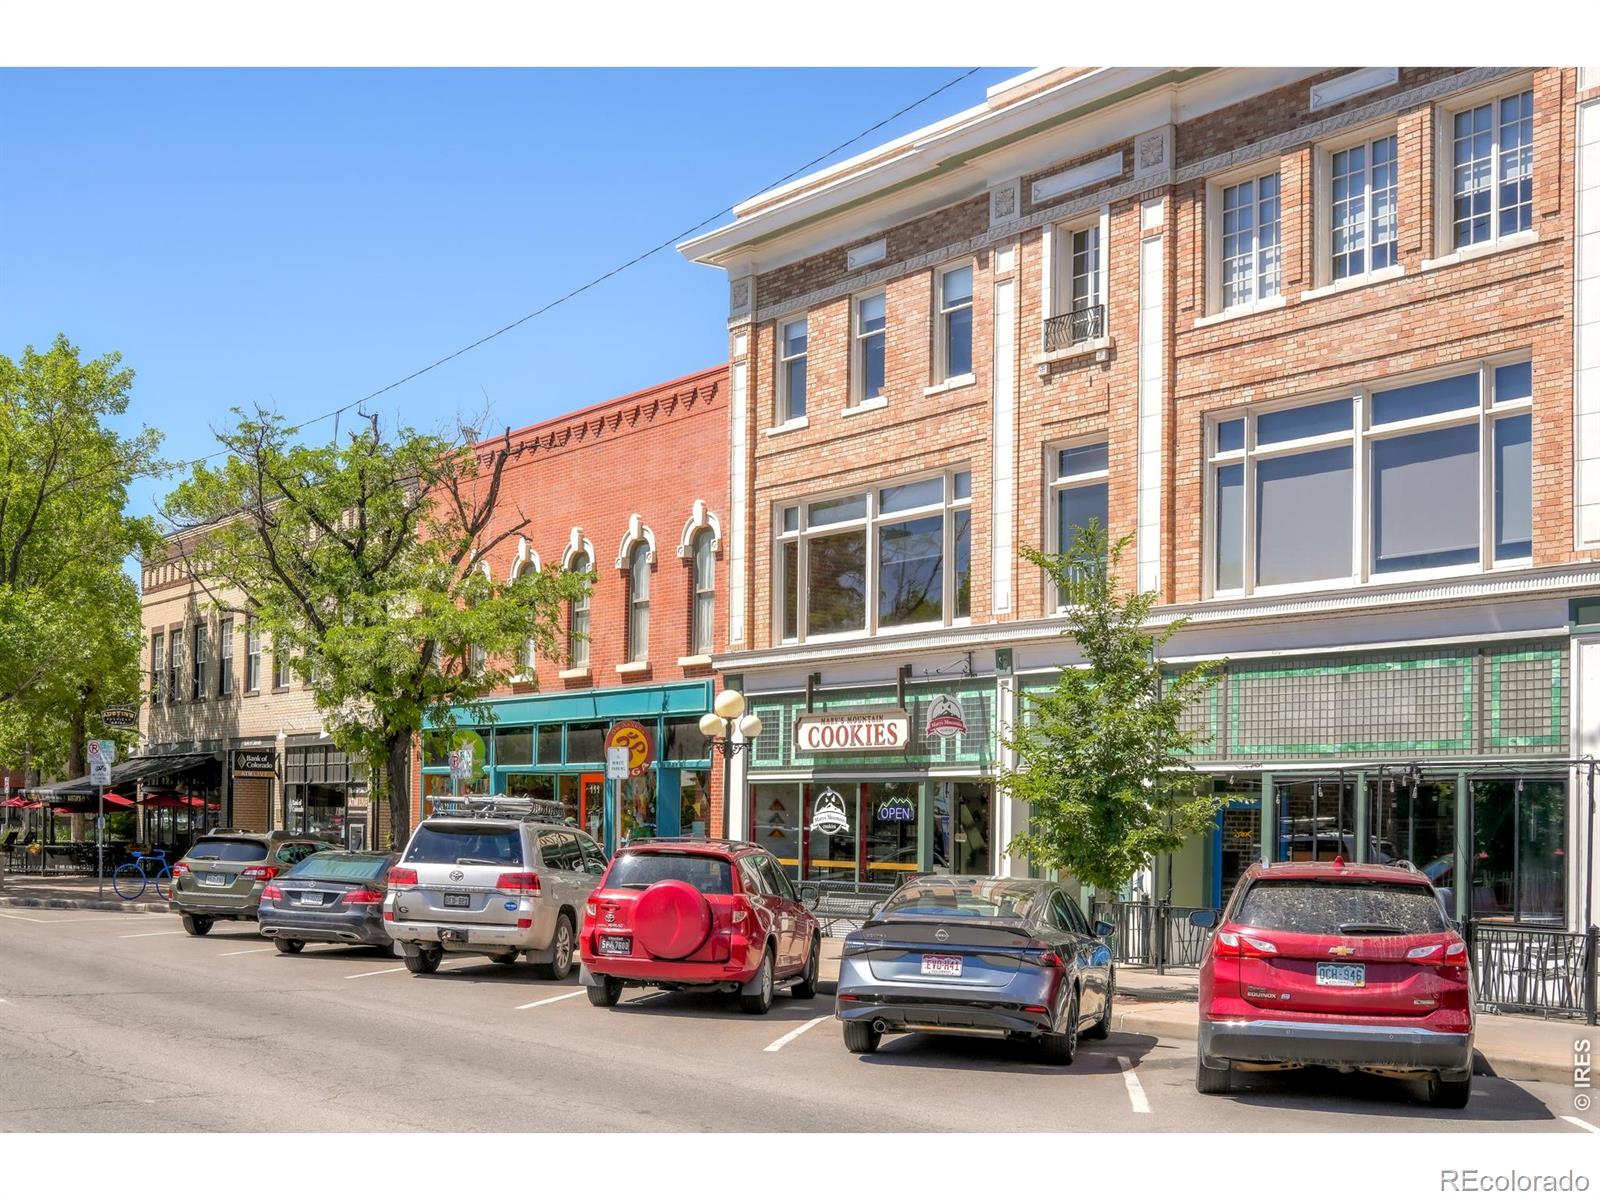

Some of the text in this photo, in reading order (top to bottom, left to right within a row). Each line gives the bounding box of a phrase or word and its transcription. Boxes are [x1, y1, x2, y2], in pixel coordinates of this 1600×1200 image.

[820, 715, 884, 725] MARY'S MOUNTAIN
[808, 723, 898, 748] COOKIES
[261, 754, 268, 762] of
[246, 761, 273, 769] Colorado
[880, 807, 910, 819] OPEN
[1247, 991, 1277, 999] EQUINOX
